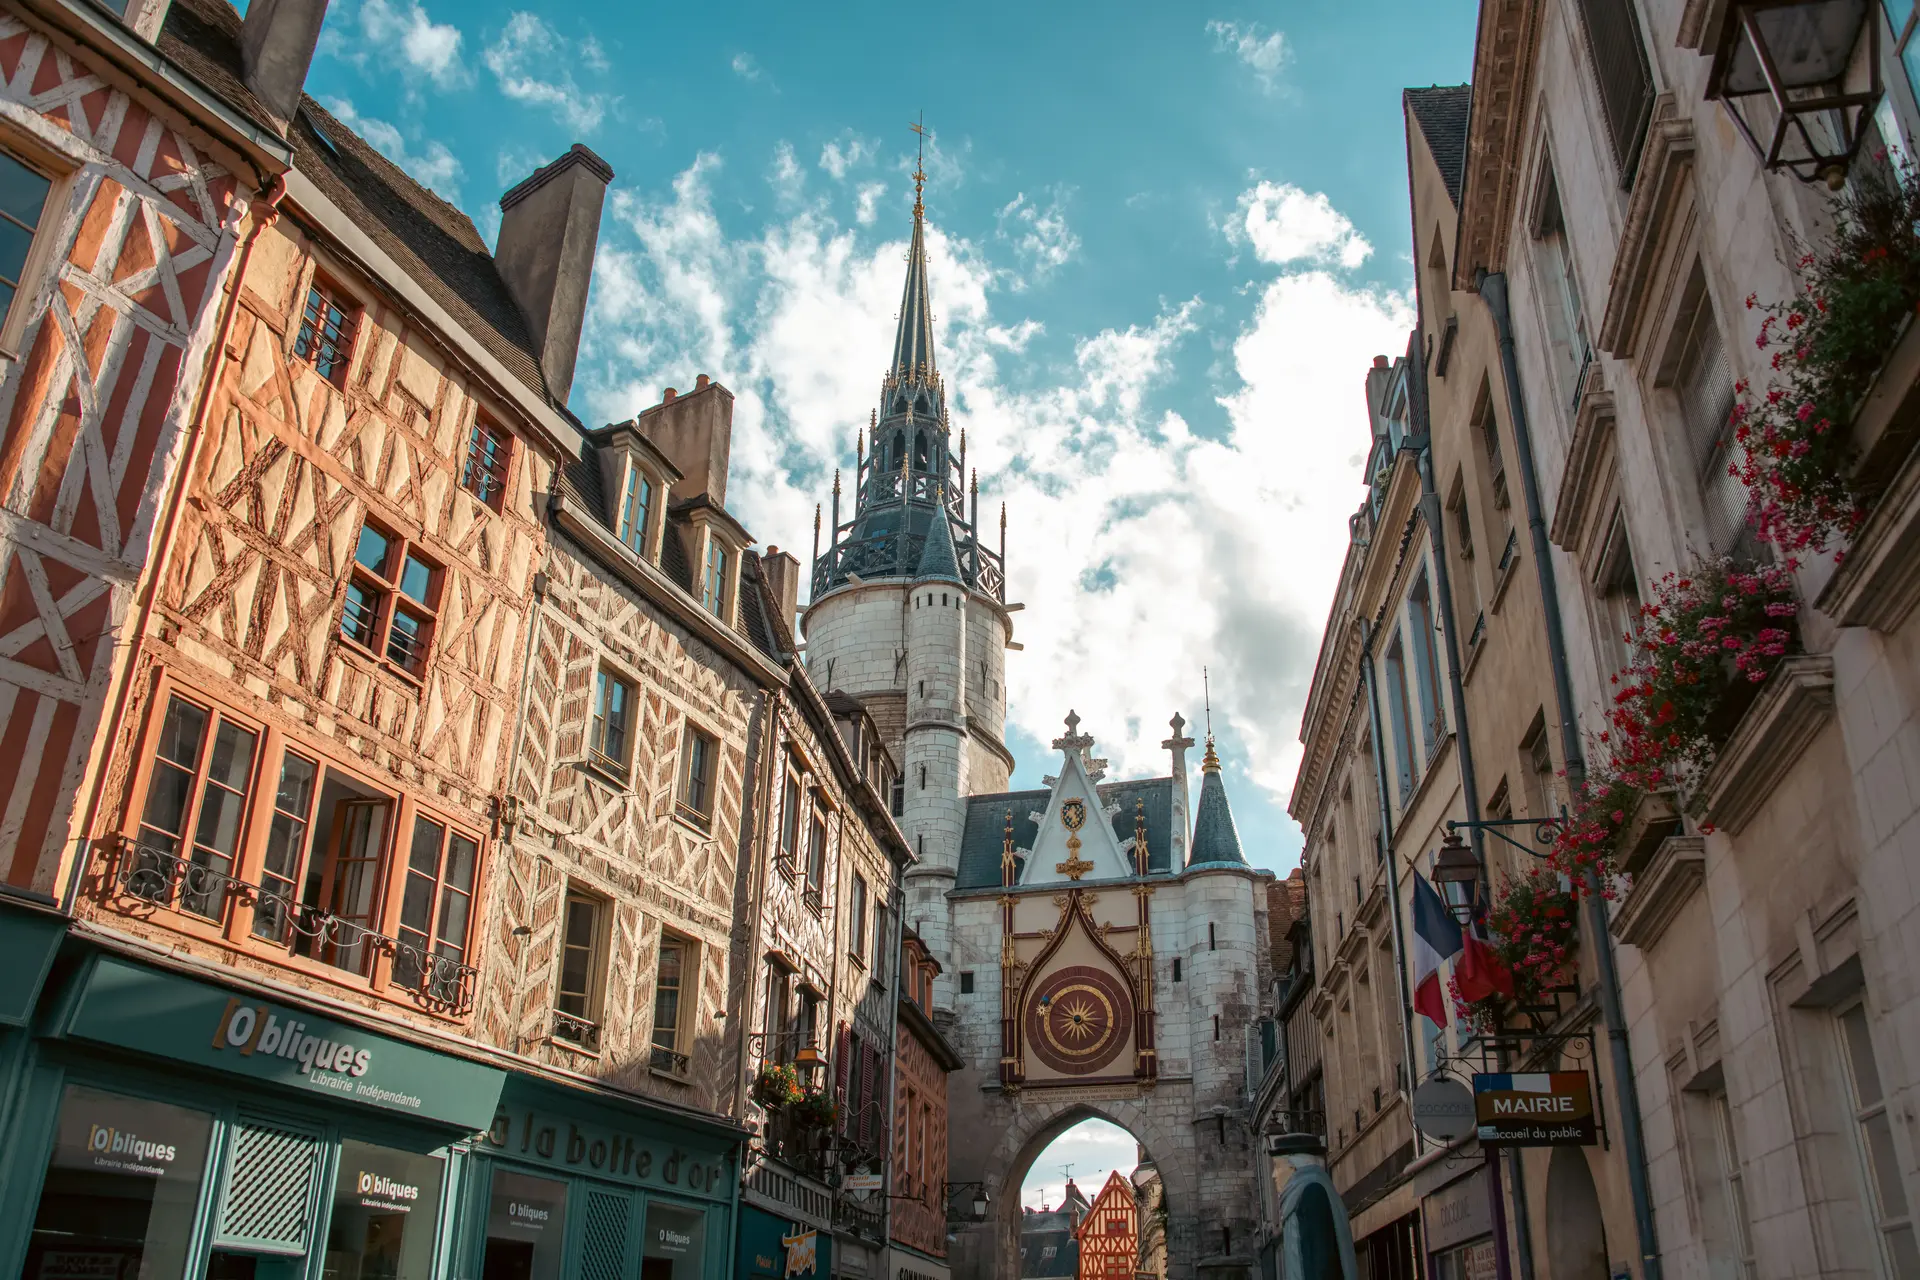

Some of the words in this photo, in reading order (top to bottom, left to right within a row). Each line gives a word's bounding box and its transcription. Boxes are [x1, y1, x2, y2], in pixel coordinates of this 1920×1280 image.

[310, 1069, 353, 1093] Librairie
[356, 1081, 422, 1109] indépendante
[1493, 1096, 1574, 1114] MAIRIE
[1533, 1127, 1546, 1139] du
[1550, 1127, 1582, 1141] public
[521, 1111, 556, 1157] la
[662, 1147, 720, 1192] d'or
[94, 1156, 122, 1168] Librairie
[122, 1161, 165, 1175] indépendante
